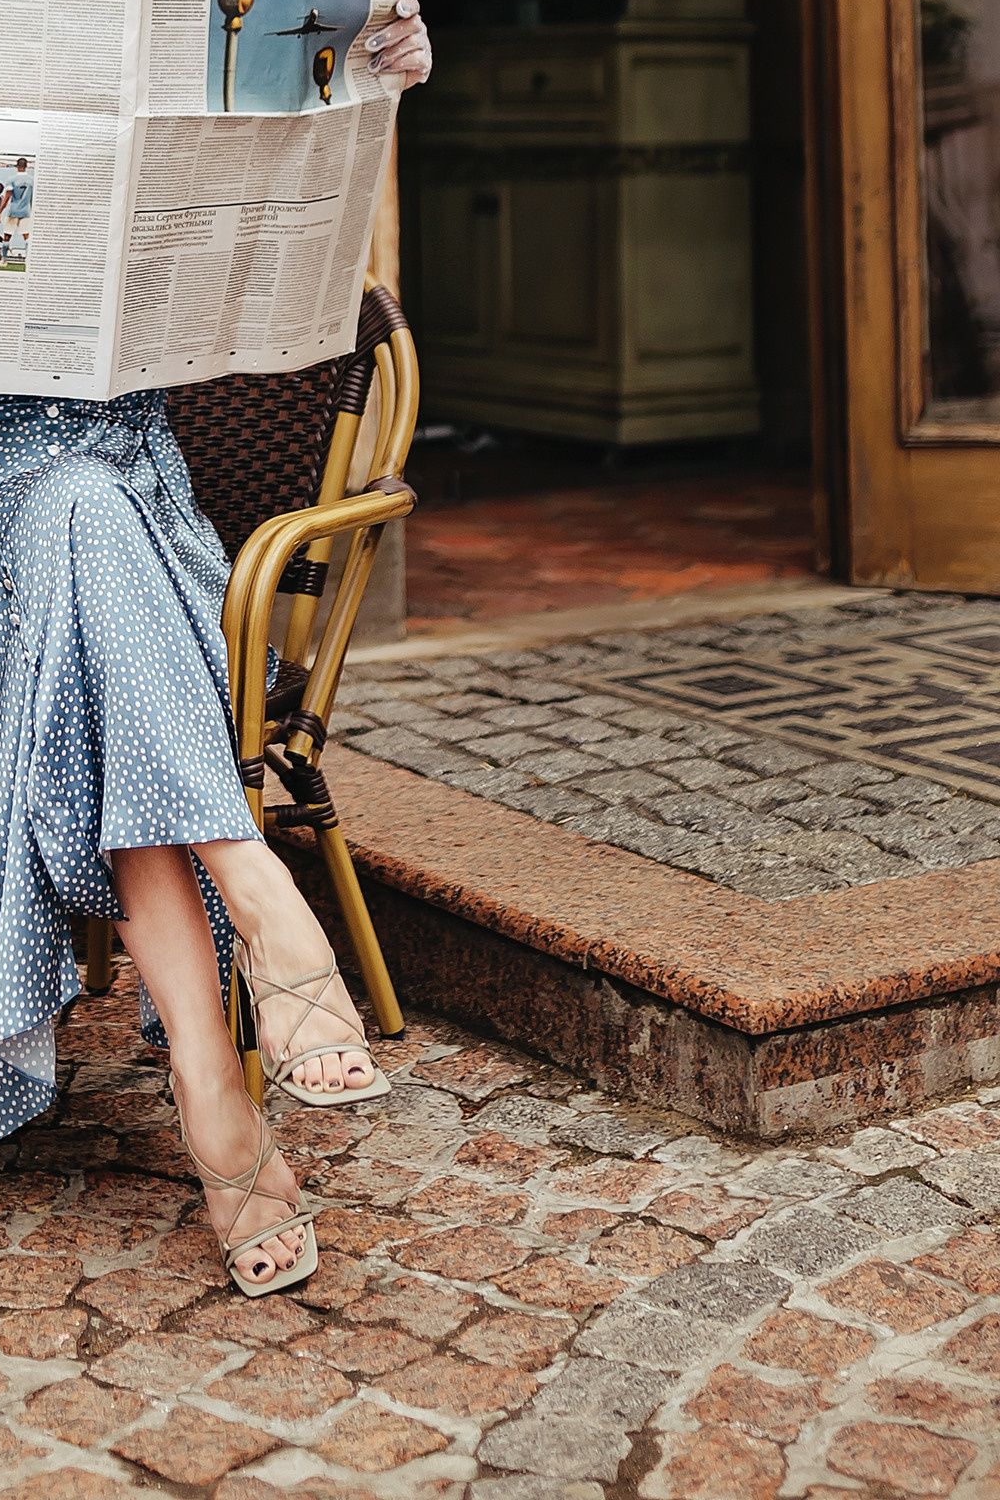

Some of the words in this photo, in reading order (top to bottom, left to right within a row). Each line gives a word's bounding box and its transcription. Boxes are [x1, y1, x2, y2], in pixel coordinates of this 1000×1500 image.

[19, 185, 28, 200] 7
[241, 204, 266, 215] Врачей
[267, 204, 308, 213] пролечат
[132, 214, 155, 223] Глаза
[156, 213, 183, 223] Сергея
[184, 210, 216, 219] Фургала
[131, 223, 172, 232] оказались
[174, 220, 213, 229] честными
